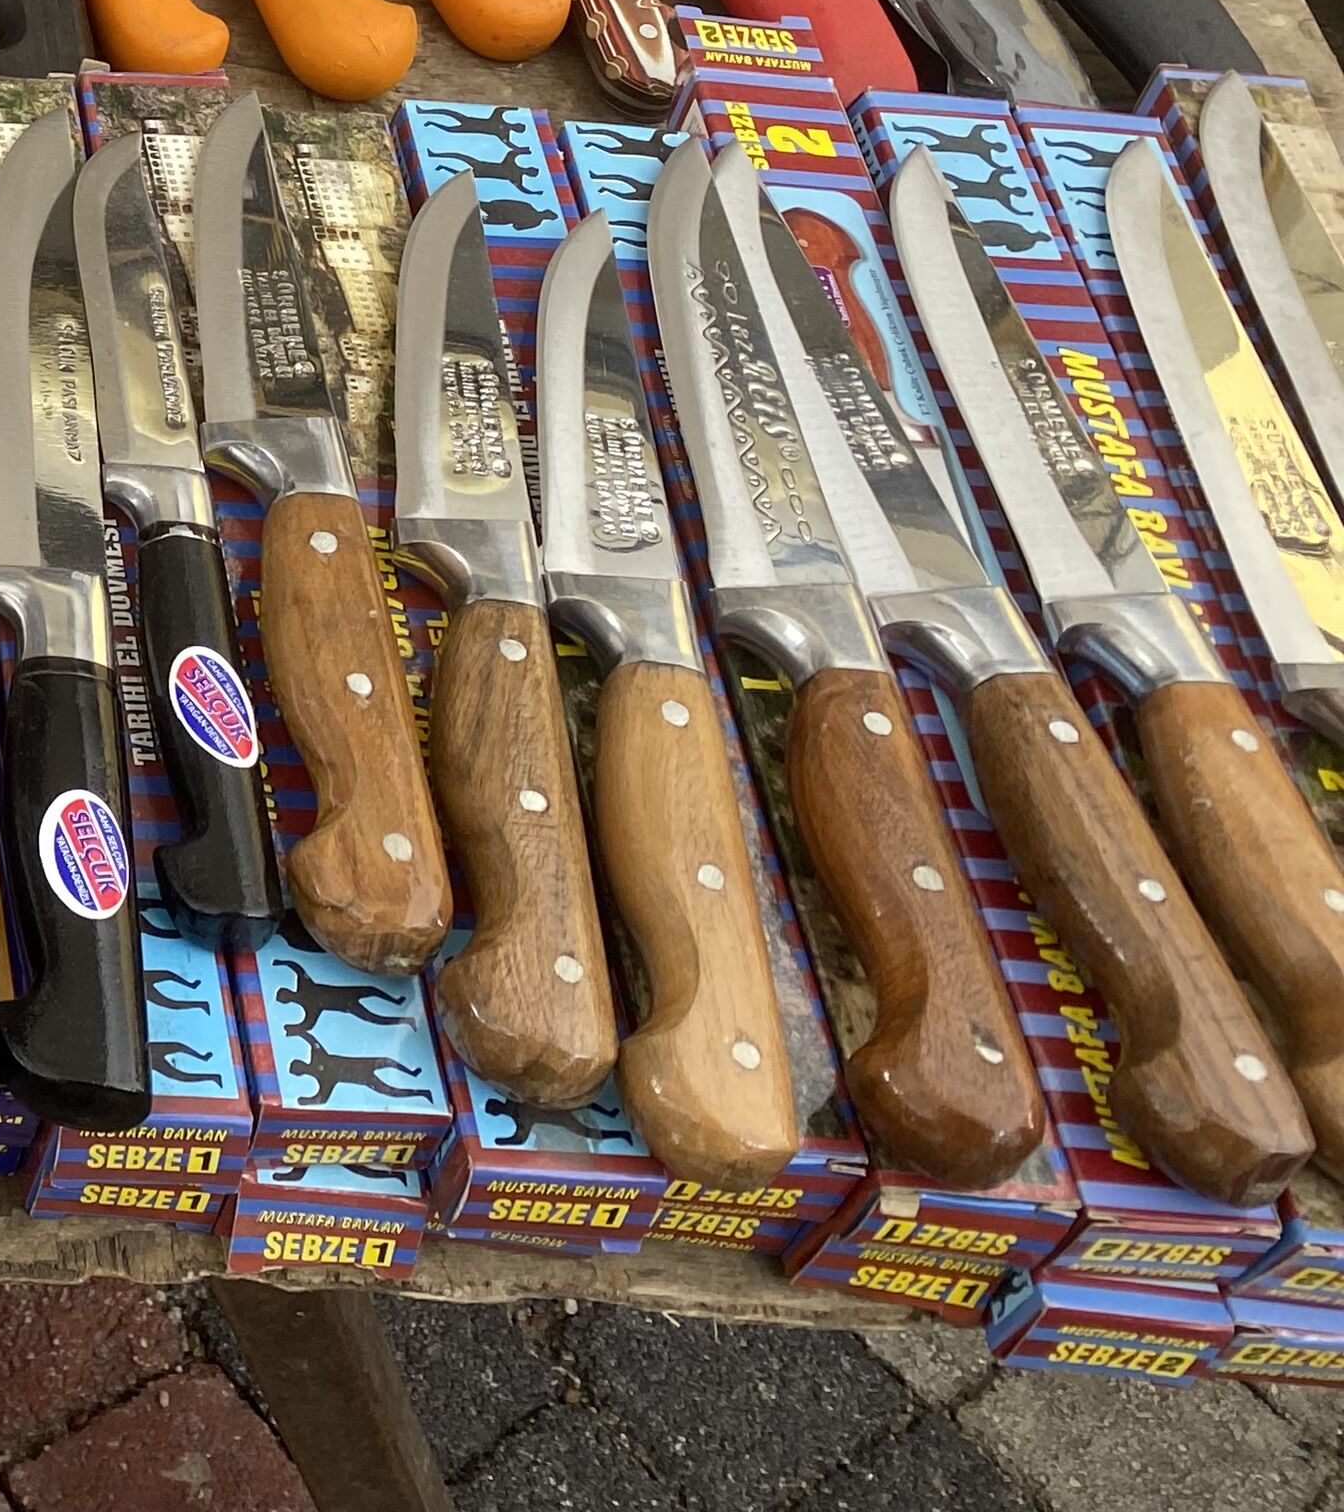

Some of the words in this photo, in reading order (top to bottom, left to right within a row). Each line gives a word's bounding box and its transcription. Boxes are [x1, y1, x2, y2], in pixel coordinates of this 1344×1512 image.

[724, 25, 799, 55] SEBZE
[705, 51, 754, 67] BAYLAN
[754, 56, 812, 72] MUSTAFA
[766, 125, 838, 158] 2
[1056, 345, 1154, 498] MUSTAFA
[115, 635, 141, 668] EL
[183, 664, 253, 745] SELÇUK
[68, 808, 121, 895] SELÇUK
[104, 833, 127, 872] SELÇUK
[163, 1127, 227, 1142] BAYLAN
[280, 1129, 357, 1141] MUSTAFA
[362, 1129, 425, 1142] BAYLAN
[86, 1144, 184, 1172] SEBZE
[282, 1144, 381, 1166] SEBZE
[79, 1185, 176, 1211] SEBZE
[486, 1180, 569, 1197] MUSTAFA
[571, 1185, 641, 1201] BAYLAN
[258, 1210, 336, 1227] MUSTAFA
[340, 1217, 406, 1236] BAYLAN
[488, 1198, 591, 1226] SEBZE
[662, 1209, 762, 1239] SEBZE
[263, 1231, 359, 1265] SEBZE
[910, 1223, 1019, 1256] SEBZE
[858, 1247, 939, 1271] MUSTAFA
[941, 1256, 1007, 1279] BAYLAN
[1127, 1242, 1232, 1268] SEBZE
[848, 1265, 948, 1303] SEBZE
[1056, 1322, 1140, 1344] MUSTAFA
[1141, 1331, 1212, 1352] BAYLAN
[1048, 1340, 1157, 1373] SEBZE
